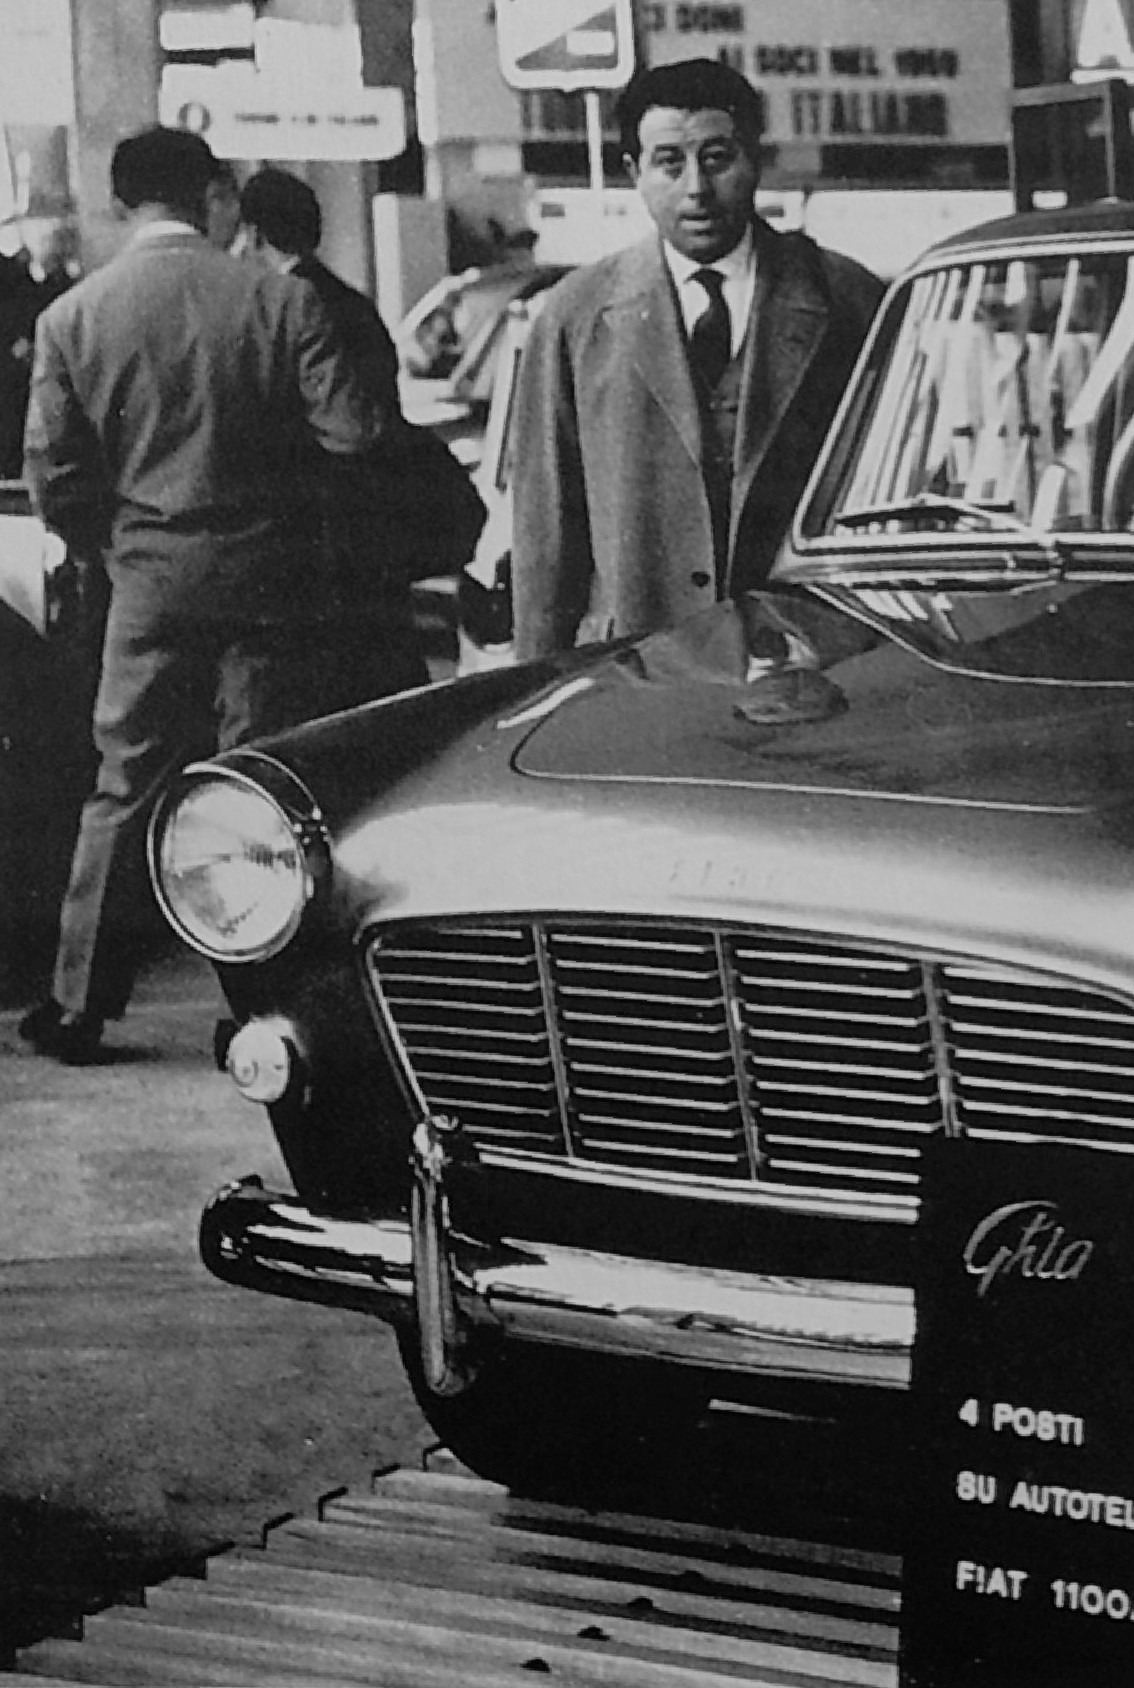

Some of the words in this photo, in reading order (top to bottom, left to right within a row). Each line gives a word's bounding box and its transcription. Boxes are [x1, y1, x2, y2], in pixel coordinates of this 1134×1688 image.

[963, 1200, 1094, 1297] Ghia
[959, 1399, 979, 1427] 4
[992, 1402, 1086, 1447] POSTI
[956, 1470, 996, 1504] SU
[956, 1560, 1029, 1601] FIAT
